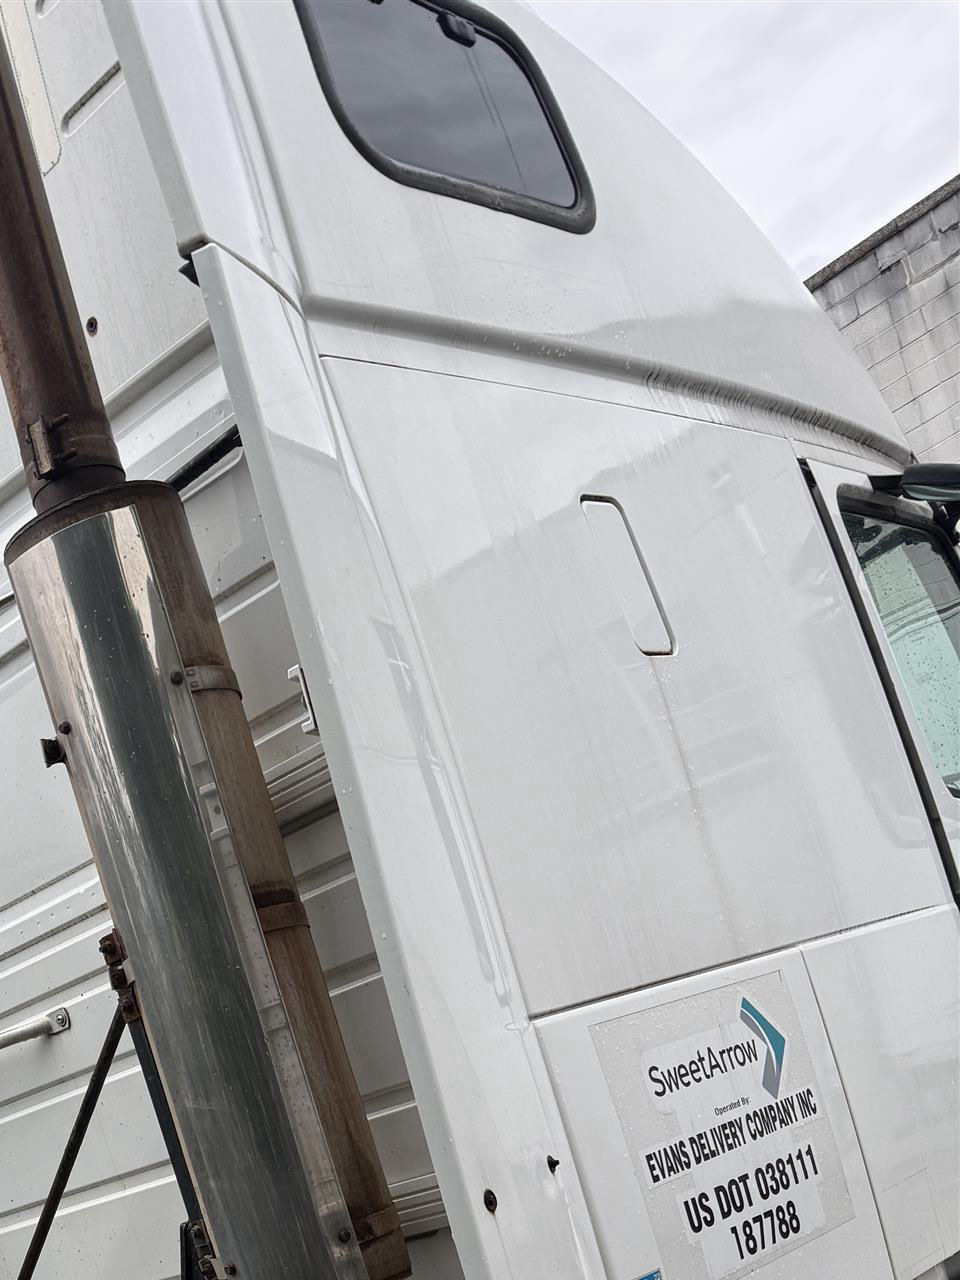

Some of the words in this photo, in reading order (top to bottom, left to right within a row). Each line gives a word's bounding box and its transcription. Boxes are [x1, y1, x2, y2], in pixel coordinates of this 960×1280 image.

[648, 1039, 758, 1097] SweetArrow
[645, 1140, 691, 1183] EVANS
[688, 1116, 746, 1165] DELIVERY
[745, 1095, 798, 1140] COMPANY
[795, 1088, 817, 1119] INC
[714, 1099, 741, 1116] Operated
[683, 1192, 715, 1233] US
[713, 1173, 753, 1220] DOT
[754, 1144, 818, 1200] 038111
[730, 1200, 800, 1260] 187788
